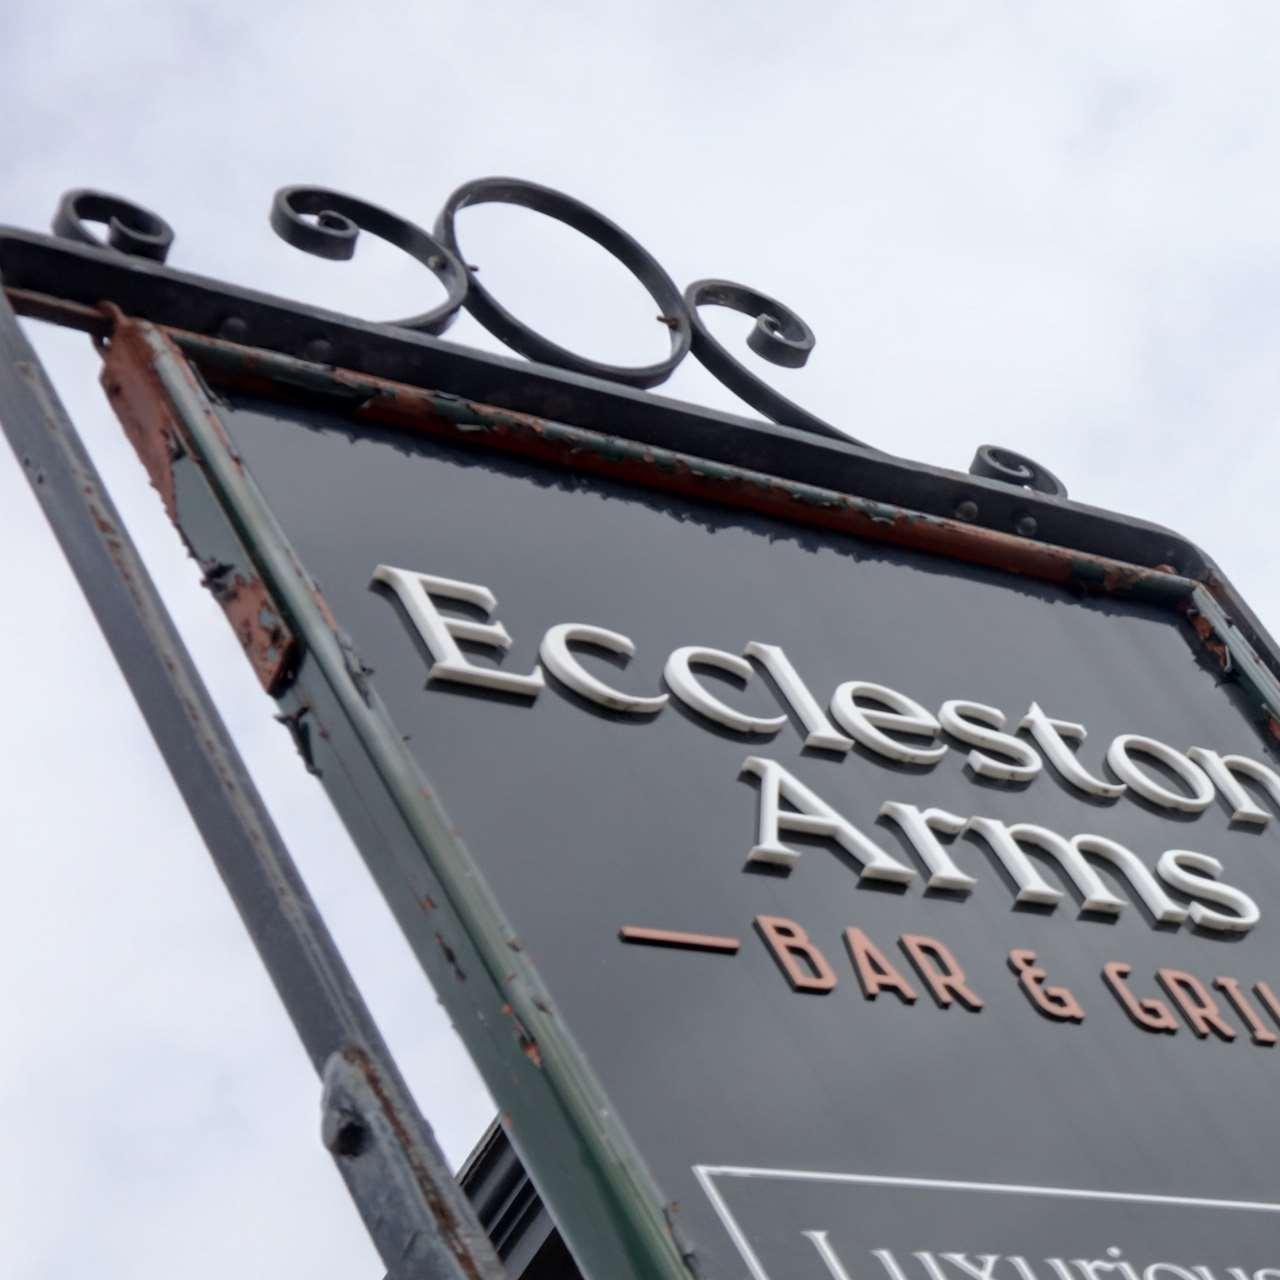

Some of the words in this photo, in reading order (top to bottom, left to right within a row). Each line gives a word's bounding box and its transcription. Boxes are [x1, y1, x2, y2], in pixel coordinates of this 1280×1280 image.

[741, 754, 1262, 935] Arms
[755, 914, 984, 1010] BAR
[1008, 948, 1084, 1021] &
